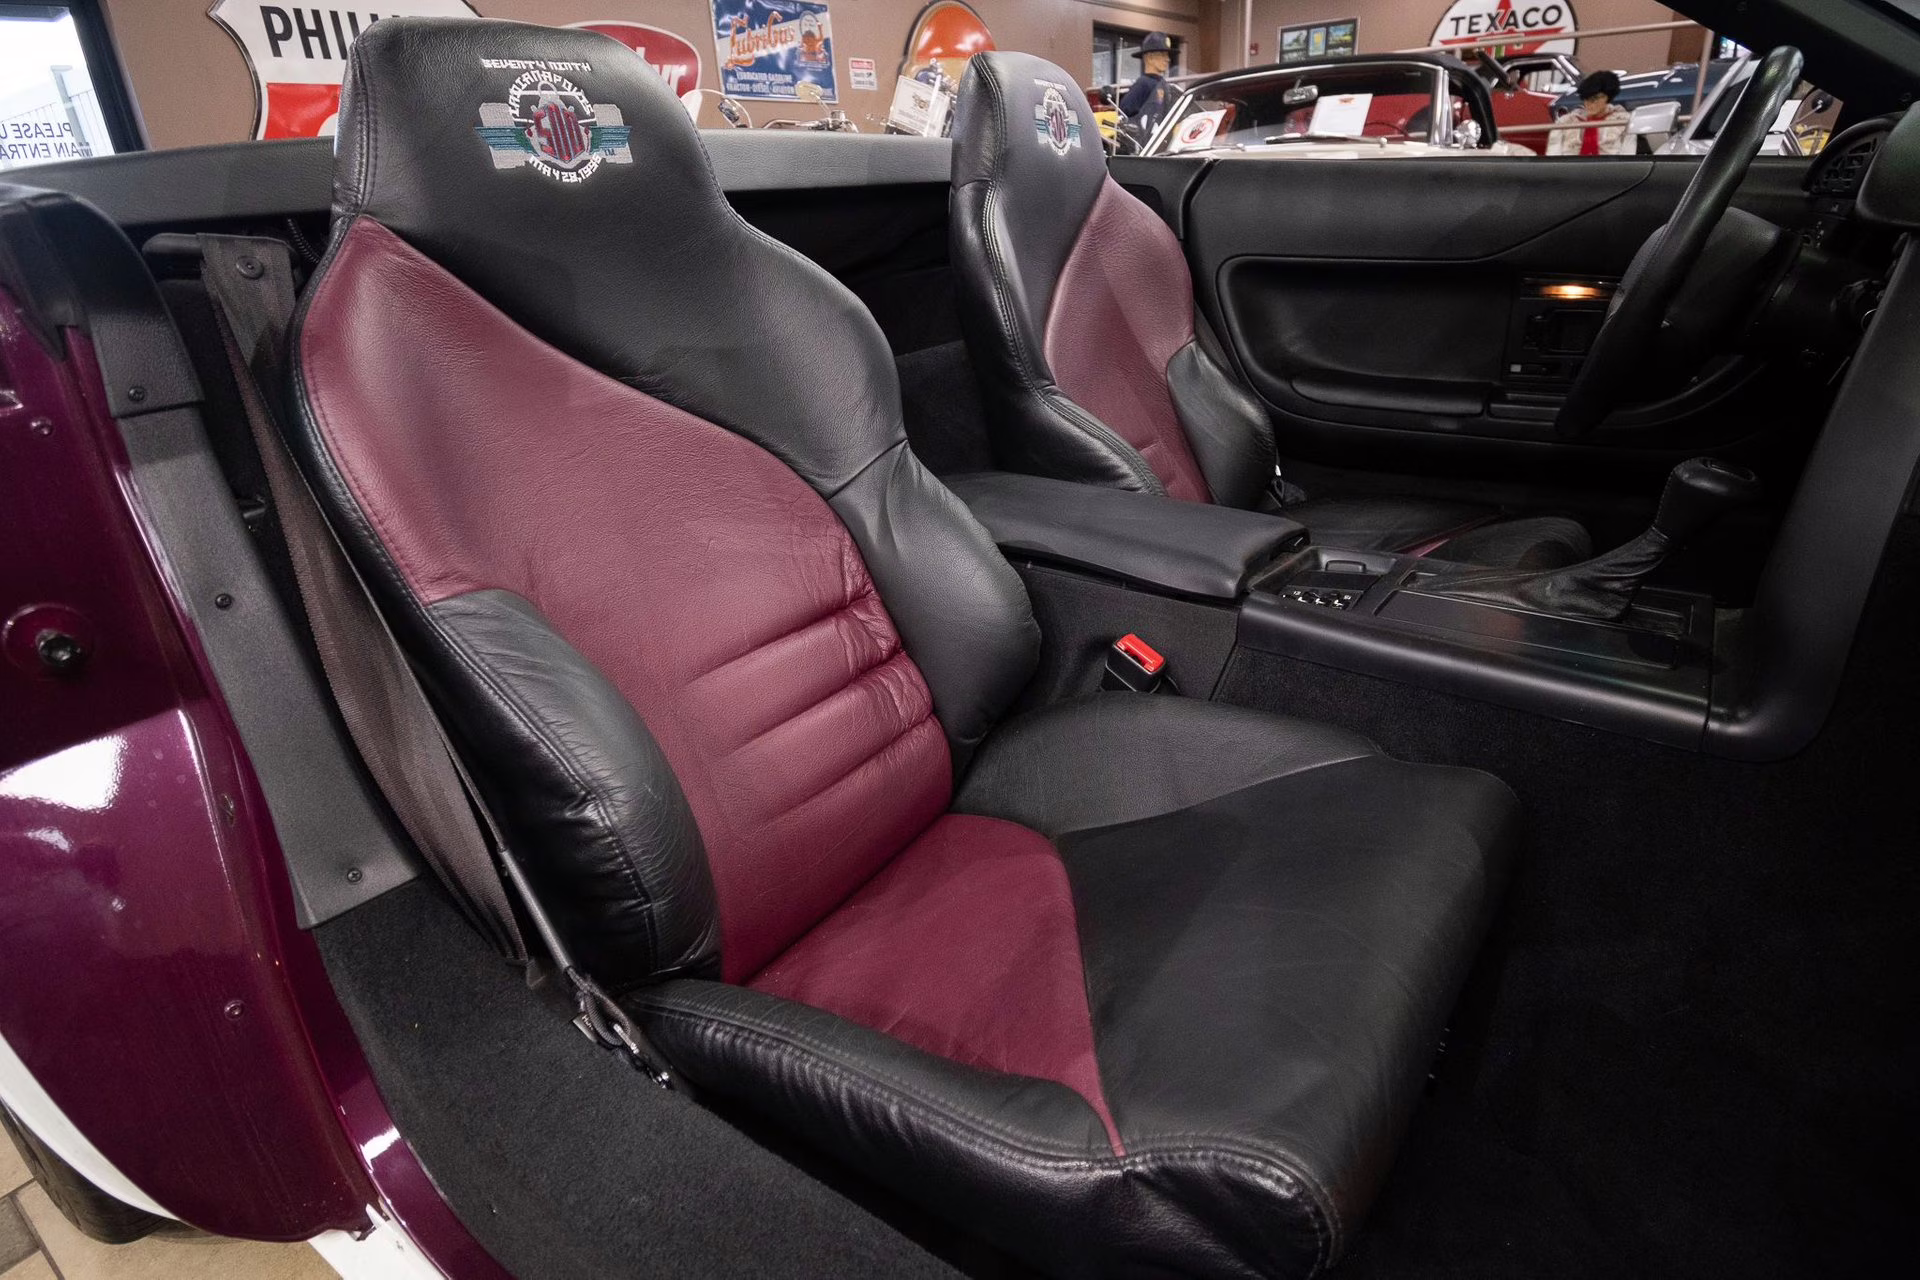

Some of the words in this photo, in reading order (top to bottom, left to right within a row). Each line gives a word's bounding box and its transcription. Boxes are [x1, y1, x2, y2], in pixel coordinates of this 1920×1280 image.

[1450, 4, 1563, 36] TEXACO
[481, 58, 547, 70] SEVENTY
[549, 60, 592, 72] NINTH
[508, 69, 595, 117] INDIANAPOLIS
[528, 155, 560, 181] MAY
